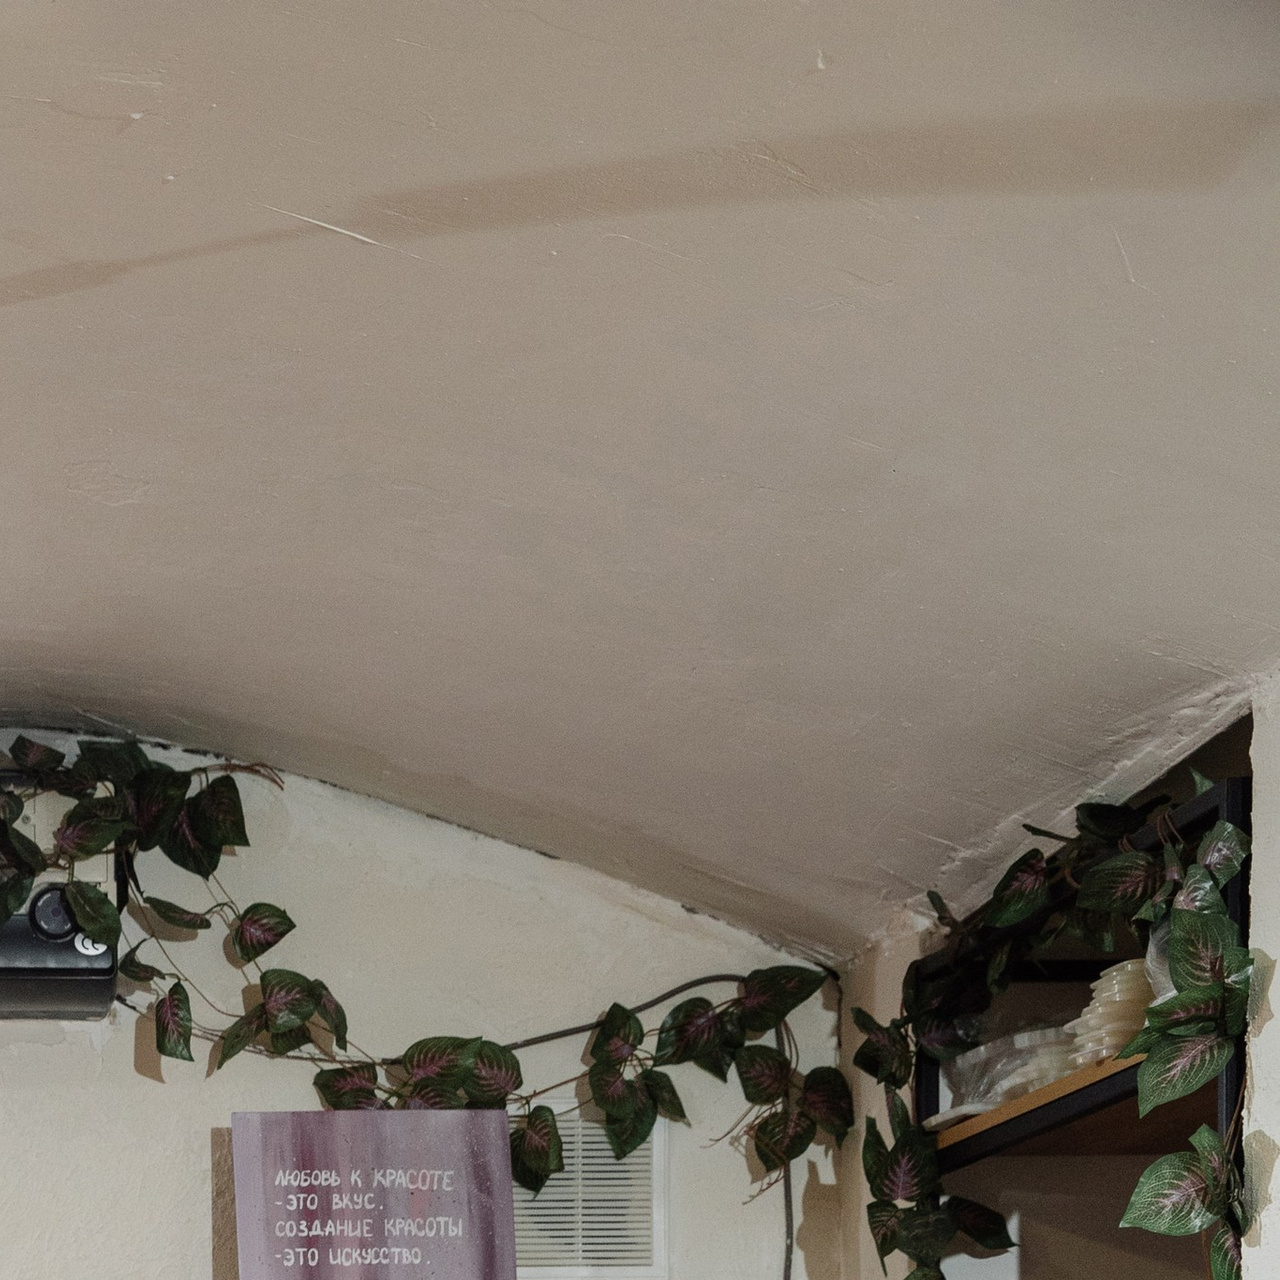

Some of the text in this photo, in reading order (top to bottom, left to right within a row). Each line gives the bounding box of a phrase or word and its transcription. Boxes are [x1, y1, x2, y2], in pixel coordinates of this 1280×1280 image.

[275, 1168, 455, 1191] ЛЮБОВЬ К КРАСОТЕ
[332, 1193, 384, 1210] ВКУС.
[275, 1216, 462, 1237] СОЗДАНИЕ КРАСОТЫ
[329, 1247, 431, 1266] ИСКУССТВО.
